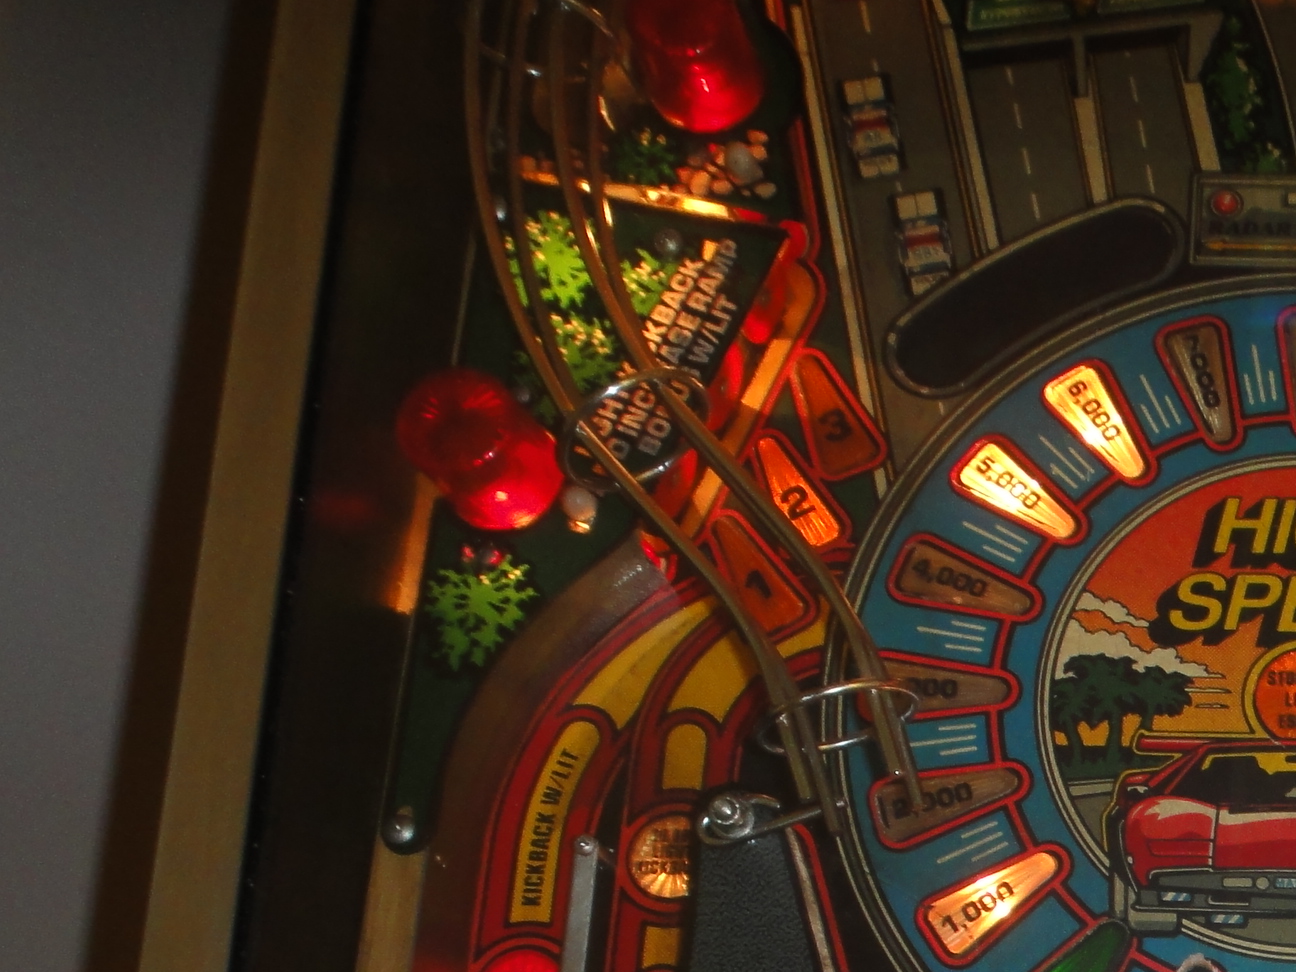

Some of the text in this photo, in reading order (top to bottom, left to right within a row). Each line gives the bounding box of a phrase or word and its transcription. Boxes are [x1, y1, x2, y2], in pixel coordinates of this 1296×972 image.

[1208, 219, 1293, 238] RADAR
[686, 237, 738, 314] RAMP
[688, 294, 738, 364] W/LIT
[818, 407, 852, 442] 3
[1068, 380, 1122, 442] 6,000
[781, 487, 813, 520] 2
[975, 455, 1041, 510] 5,000
[911, 557, 989, 598] 4,000
[521, 747, 580, 907] KICKBACK W/LIT
[941, 880, 1015, 932] 1,000
